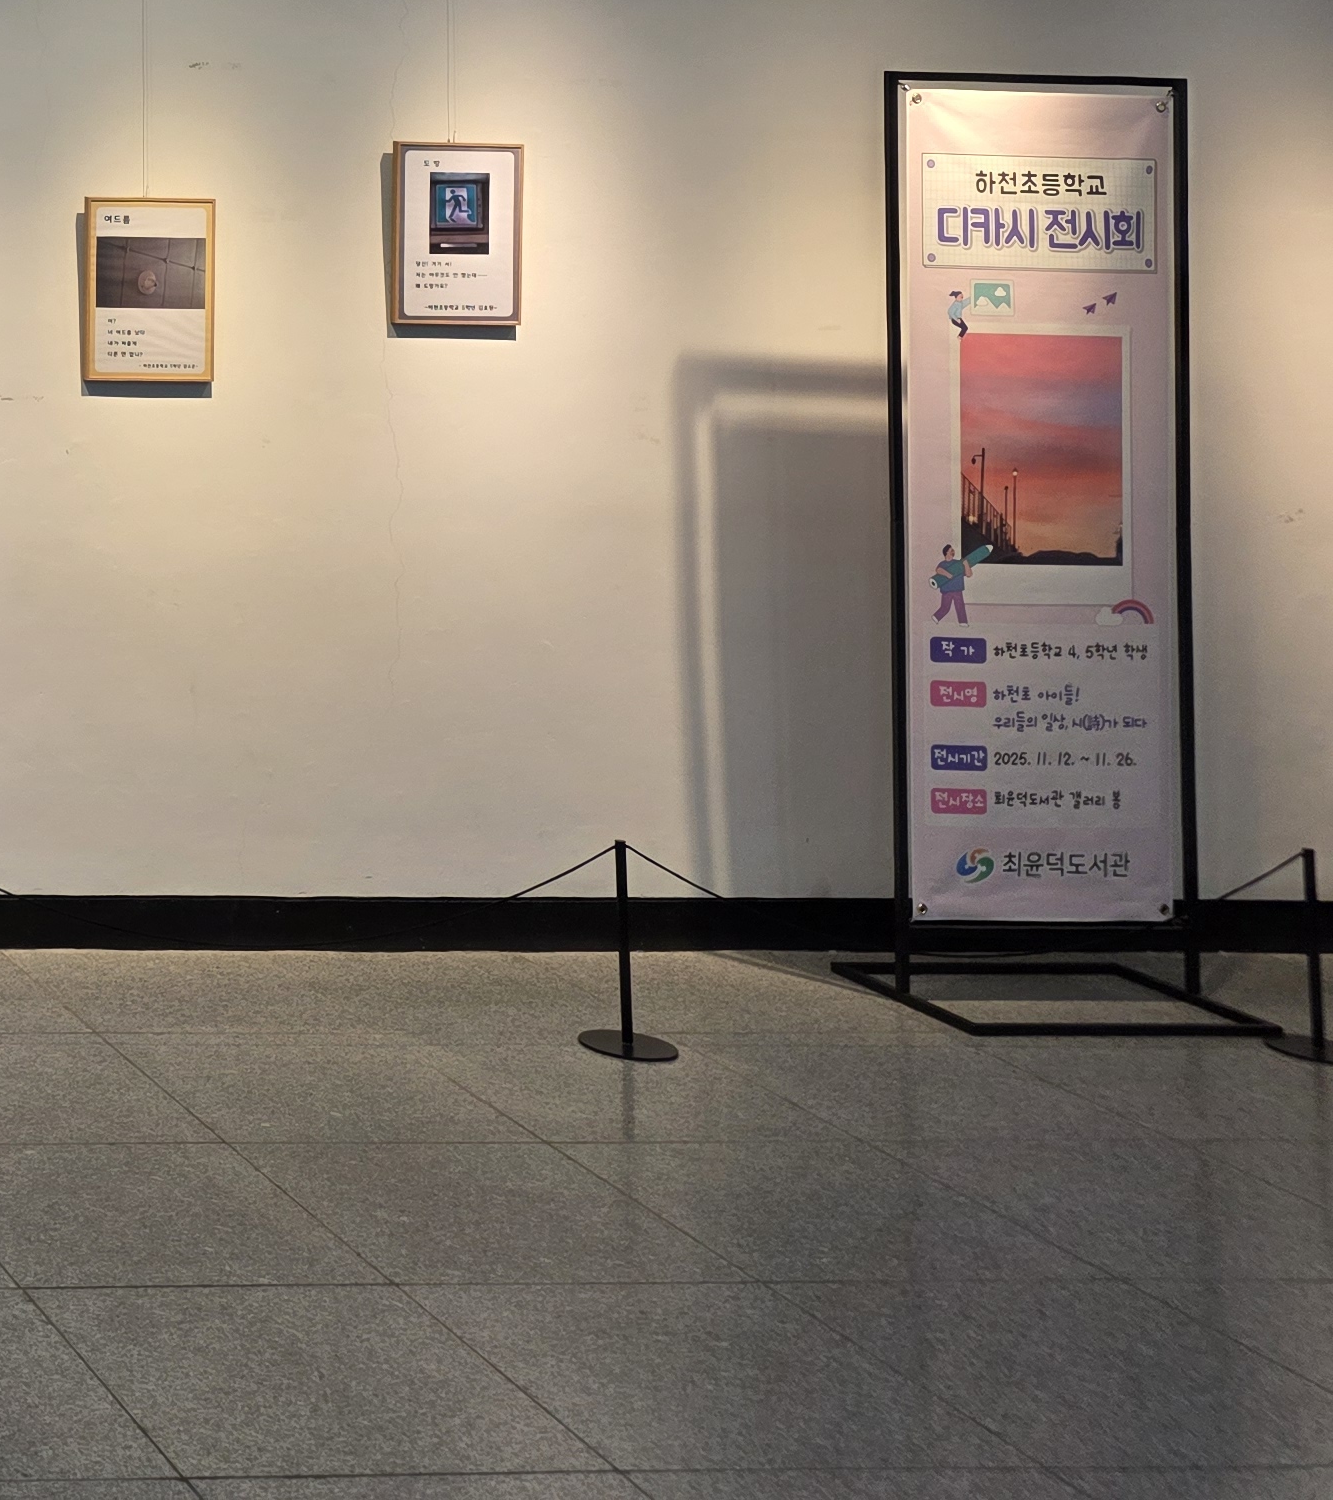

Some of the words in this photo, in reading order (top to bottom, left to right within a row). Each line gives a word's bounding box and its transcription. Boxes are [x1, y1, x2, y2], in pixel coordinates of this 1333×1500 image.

[975, 170, 1107, 197] 하천초등학교
[937, 206, 1036, 249] 디카시
[1044, 209, 1141, 250] 전시회
[993, 641, 1062, 660] 하천초등학교
[1068, 644, 1080, 660] 4,
[1085, 642, 1118, 660] 5학년
[1123, 642, 1148, 660] 학생
[993, 685, 1031, 703] 하천초
[1037, 683, 1080, 706] 아이들!
[993, 711, 1037, 732] 우리들의
[1041, 712, 1069, 732] 일상,
[1122, 715, 1148, 729] 되다
[934, 748, 985, 767] 전시기간
[993, 751, 1031, 766] 2025.
[1037, 751, 1052, 766] 11.
[1058, 751, 1075, 766] 12.
[1095, 752, 1111, 767] 11.
[1116, 751, 1137, 767] 26.
[935, 791, 985, 809] 전시장소
[994, 790, 1064, 808] 최윤덕도서관
[1069, 790, 1106, 809] 갤러리
[1002, 851, 1130, 878] 최윤덕도서관
